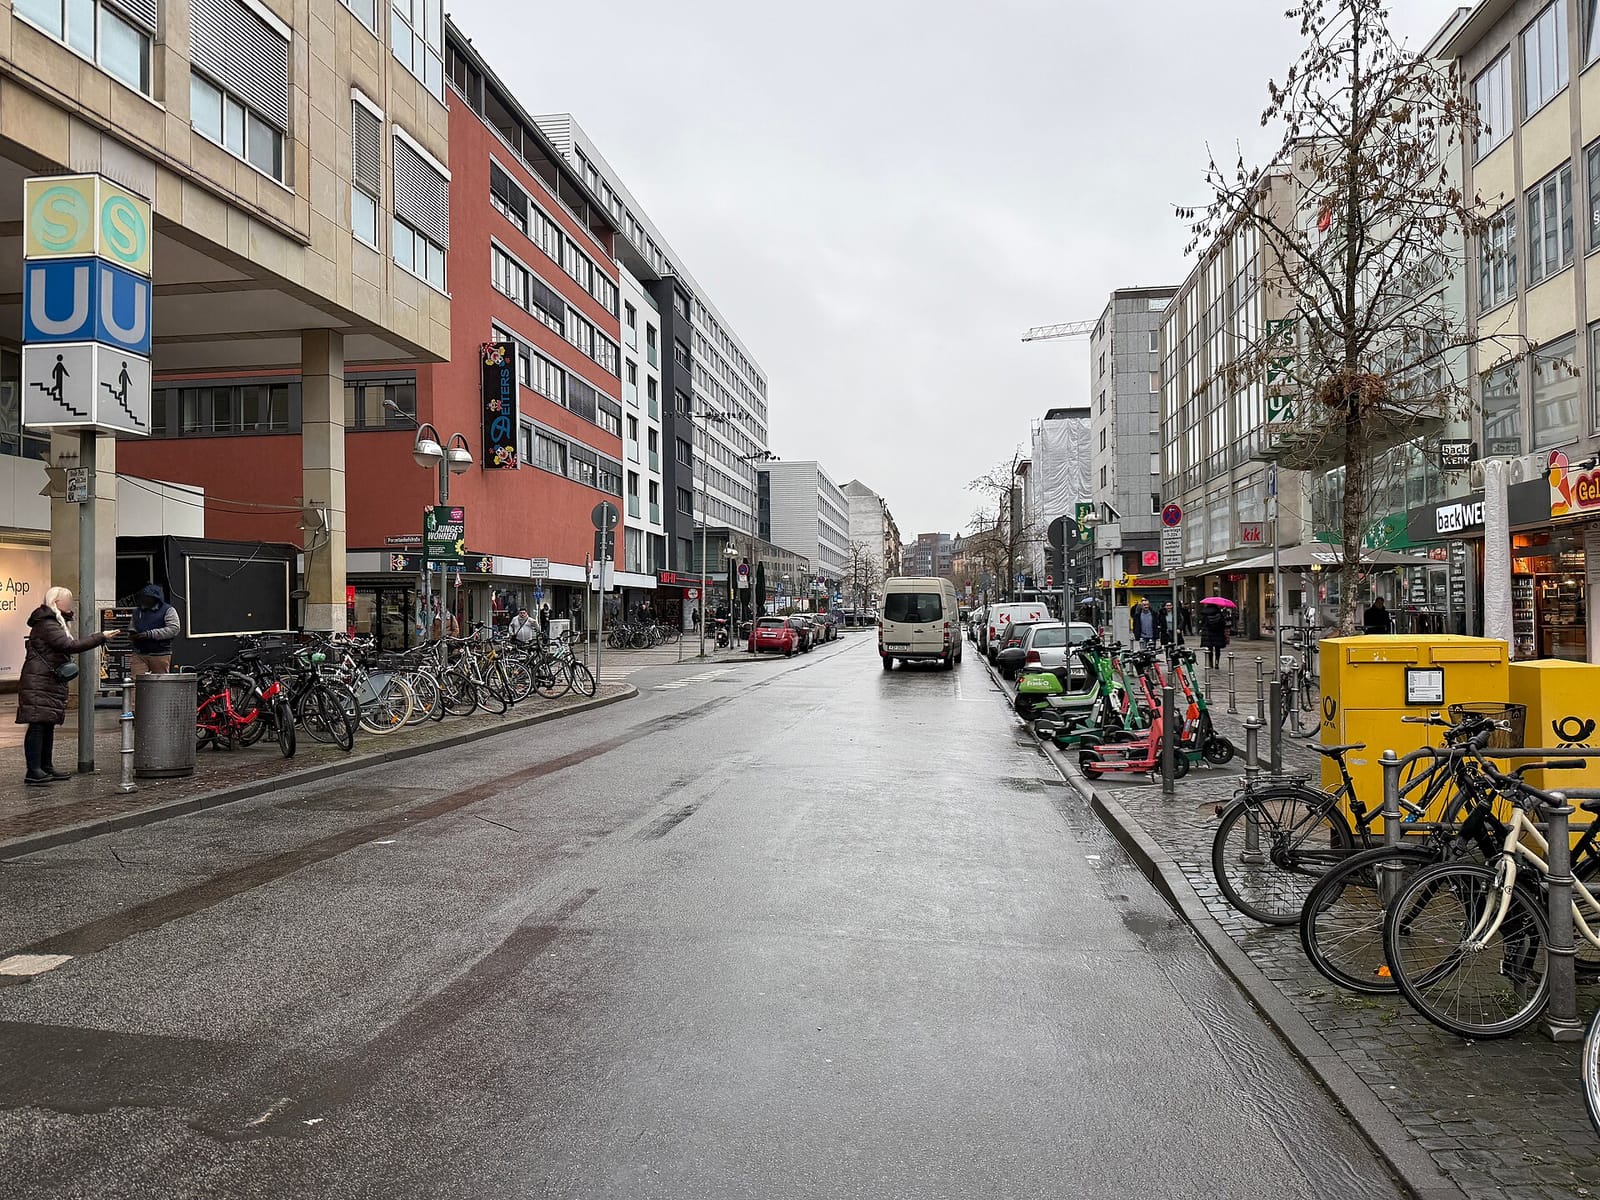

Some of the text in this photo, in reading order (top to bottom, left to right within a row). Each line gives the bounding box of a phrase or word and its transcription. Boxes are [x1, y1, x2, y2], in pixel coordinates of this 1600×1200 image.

[30, 266, 90, 336] U
[101, 268, 147, 345] U
[490, 367, 512, 443] DEITERS
[1442, 444, 1469, 455] back
[1579, 477, 1600, 500] Gel
[427, 532, 458, 540] WOHNEN
[438, 525, 464, 533] JUNGES
[1243, 527, 1261, 541] kik
[6, 577, 30, 596] App
